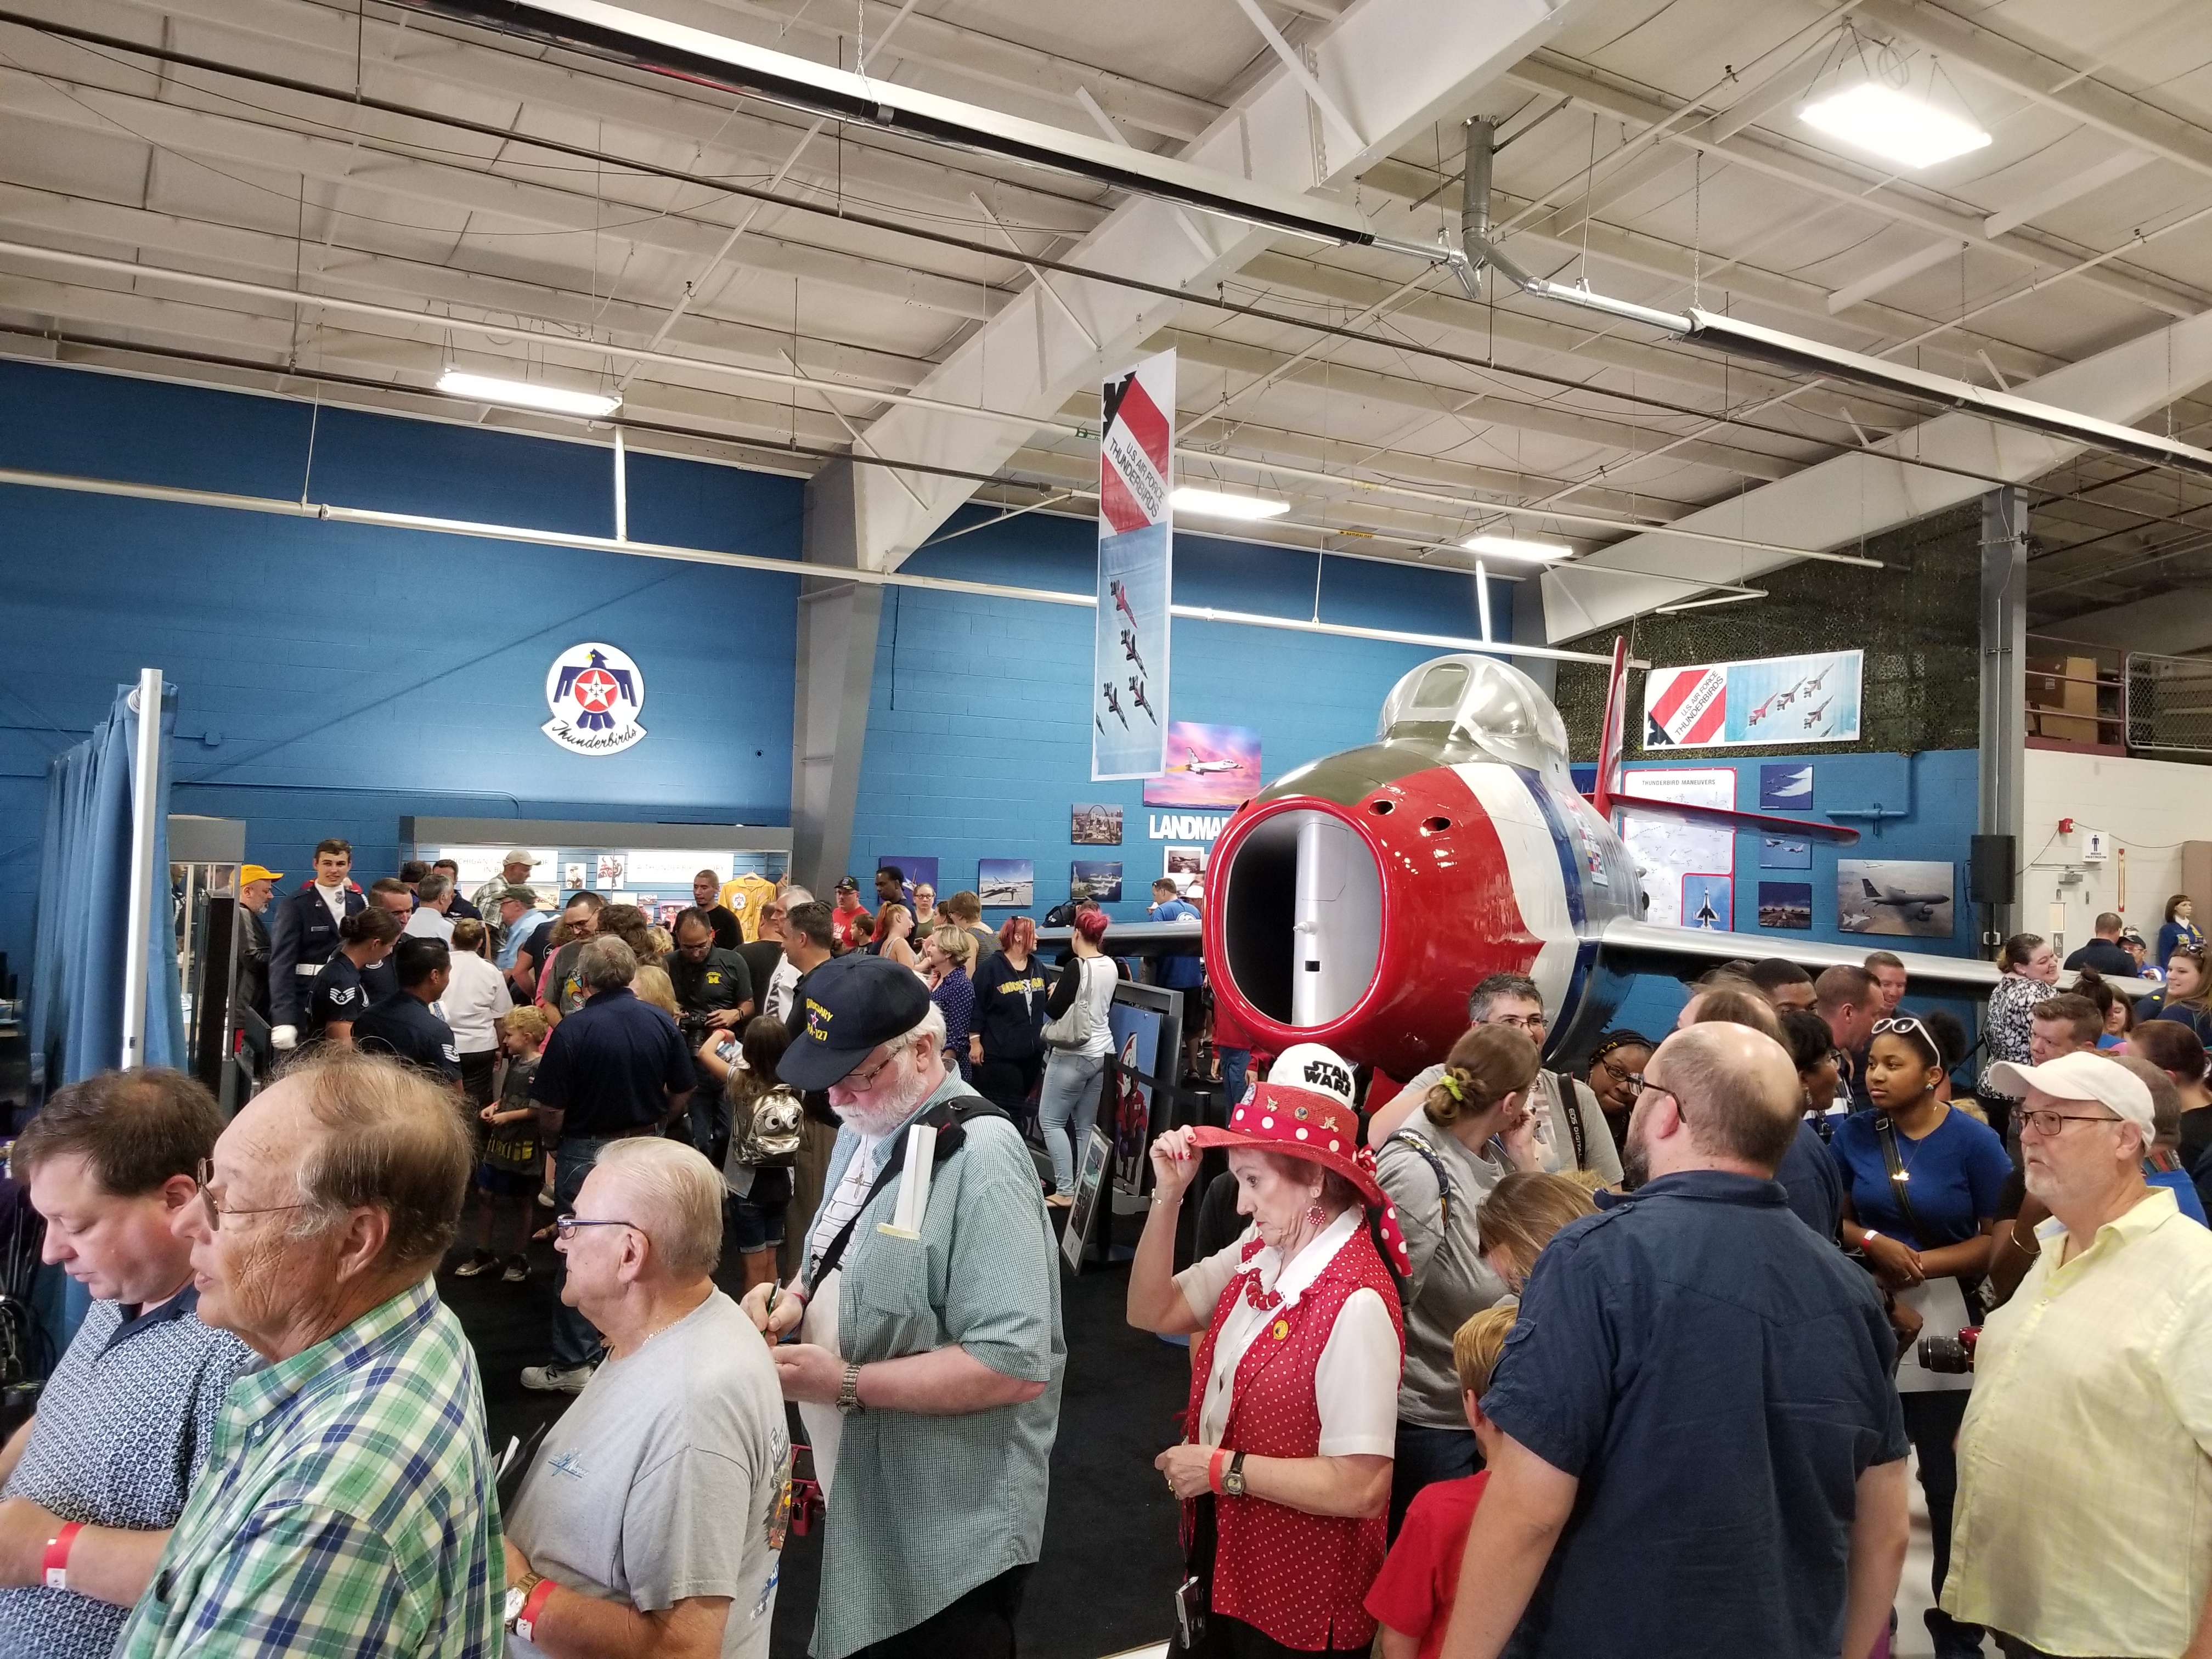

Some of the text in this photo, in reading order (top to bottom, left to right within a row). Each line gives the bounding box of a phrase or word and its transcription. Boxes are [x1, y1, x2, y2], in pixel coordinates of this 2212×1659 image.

[1109, 437, 1160, 518] THUNDERBIRDS
[1127, 442, 1165, 505] U.S. AIR FORCE
[1675, 676, 1724, 736] THUNDERBIRDS
[1680, 670, 1718, 716] U.S. AIR FORCE
[552, 720, 637, 749] Thunderbirds
[1149, 815, 1229, 840] LANDMA
[1304, 1060, 1350, 1083] STAR
[1304, 1069, 1351, 1097] WARS
[1568, 1108, 1583, 1159] EOS DIGITAL
